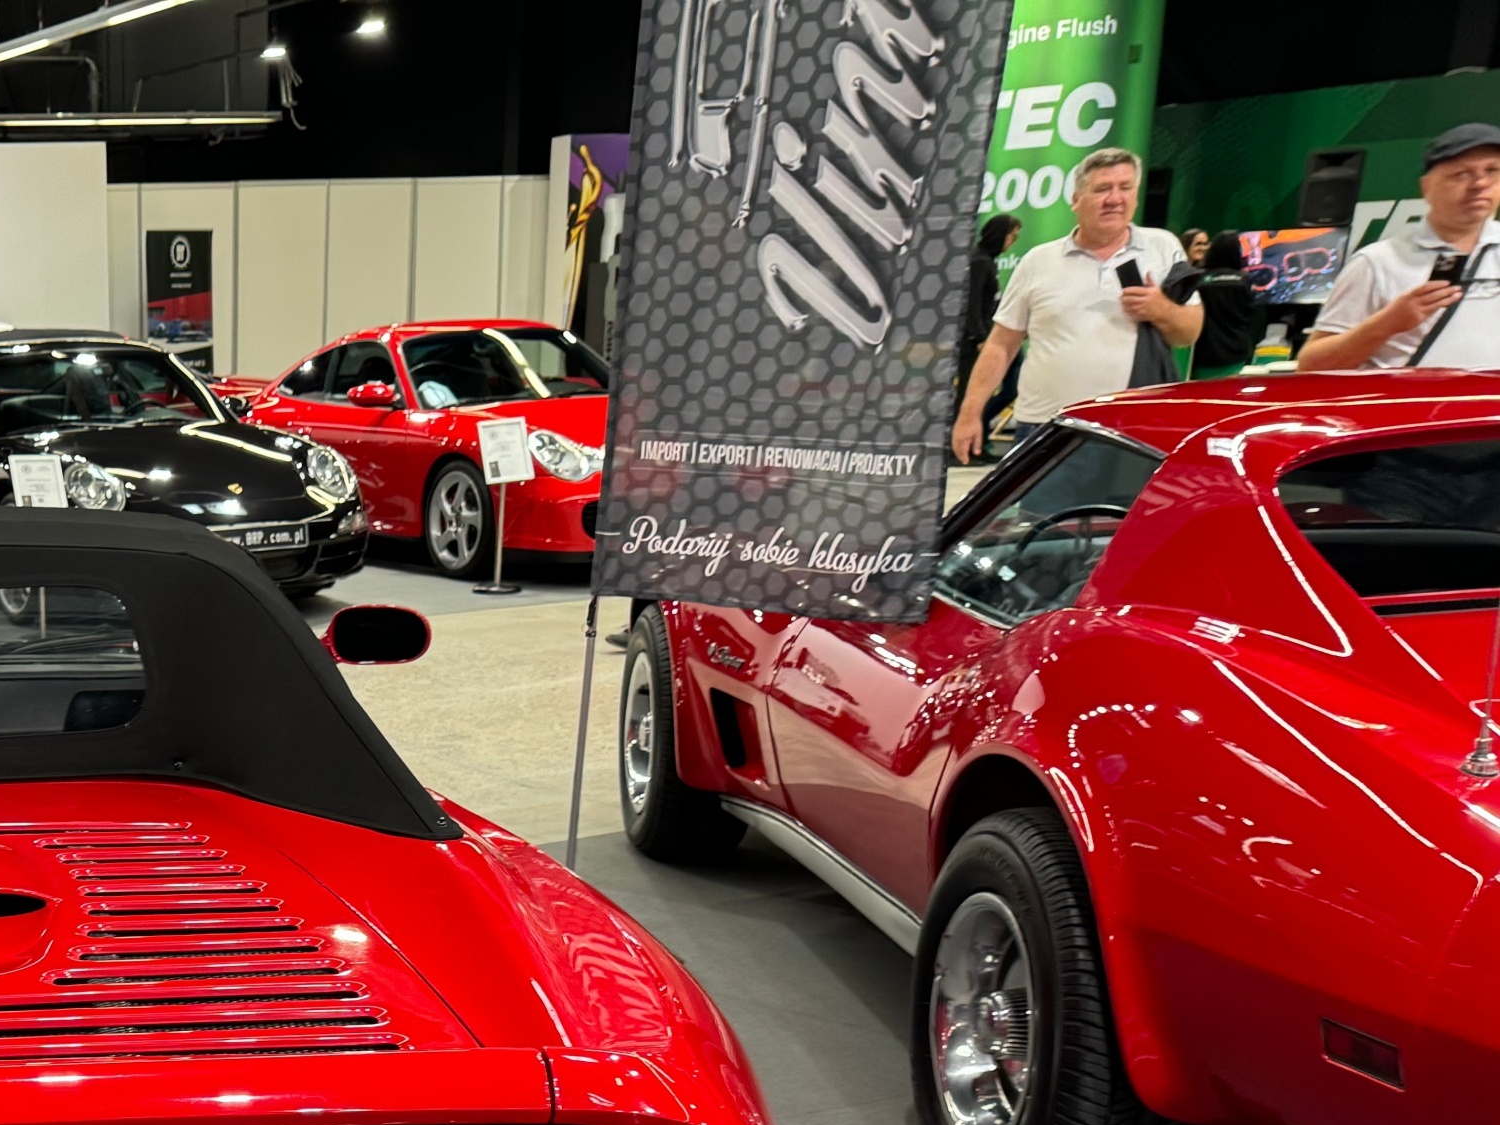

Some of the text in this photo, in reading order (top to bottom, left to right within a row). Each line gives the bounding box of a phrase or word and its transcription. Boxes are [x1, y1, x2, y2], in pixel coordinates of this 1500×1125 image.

[1008, 14, 1118, 50] gine Flush
[640, 440, 918, 477] IMPORT EXPORT RENOWACJA PROJEKTY
[739, 526, 801, 567] sobie
[807, 531, 915, 594] klasyka
